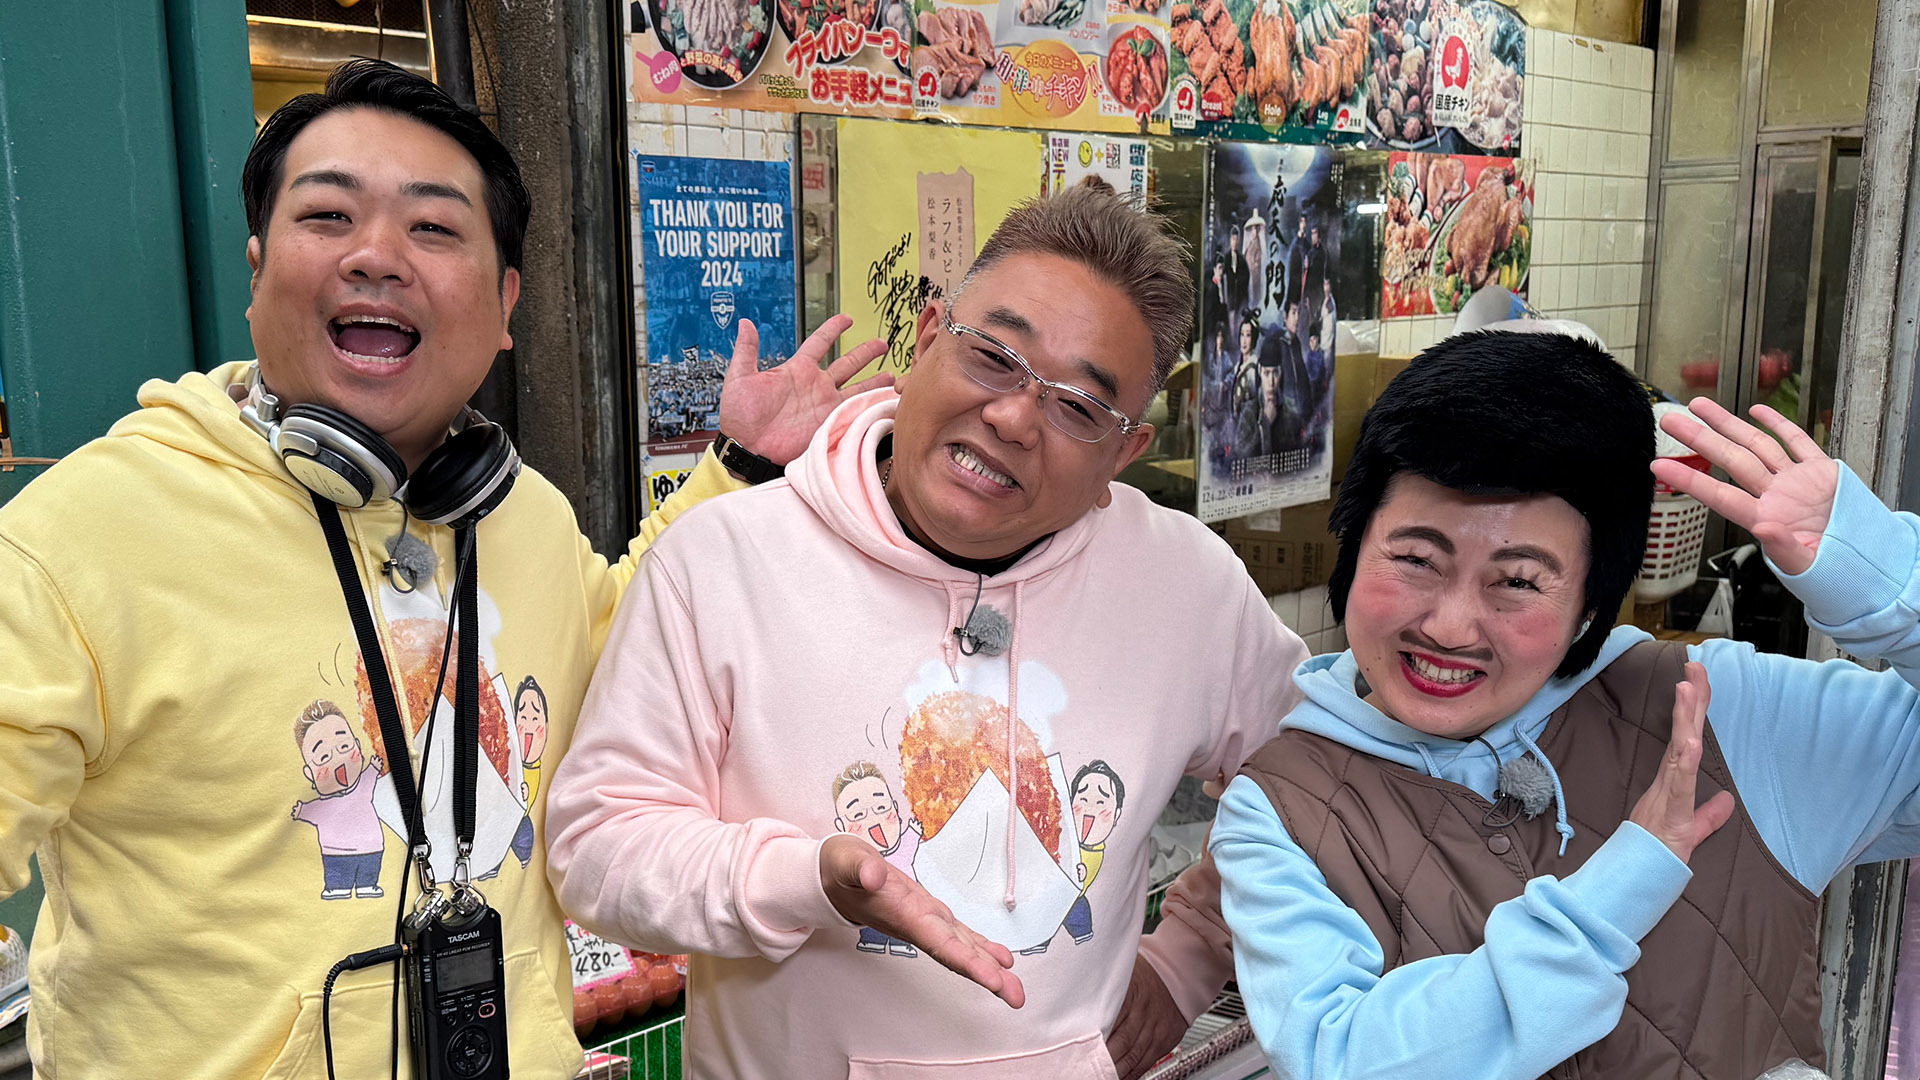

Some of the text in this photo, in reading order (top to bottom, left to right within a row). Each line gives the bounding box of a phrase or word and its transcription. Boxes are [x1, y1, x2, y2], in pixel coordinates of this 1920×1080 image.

[652, 60, 680, 85] むね肉
[1024, 52, 1078, 71] 今日のメニューは
[1264, 103, 1282, 117] Hole
[1435, 93, 1470, 112] 国産チキン
[649, 198, 784, 229] THANK YOU FOR
[927, 196, 936, 261] 松本梨香
[655, 230, 782, 258] YOUR SUPPORT
[701, 260, 743, 287] 2024
[448, 930, 480, 944] TASCAM
